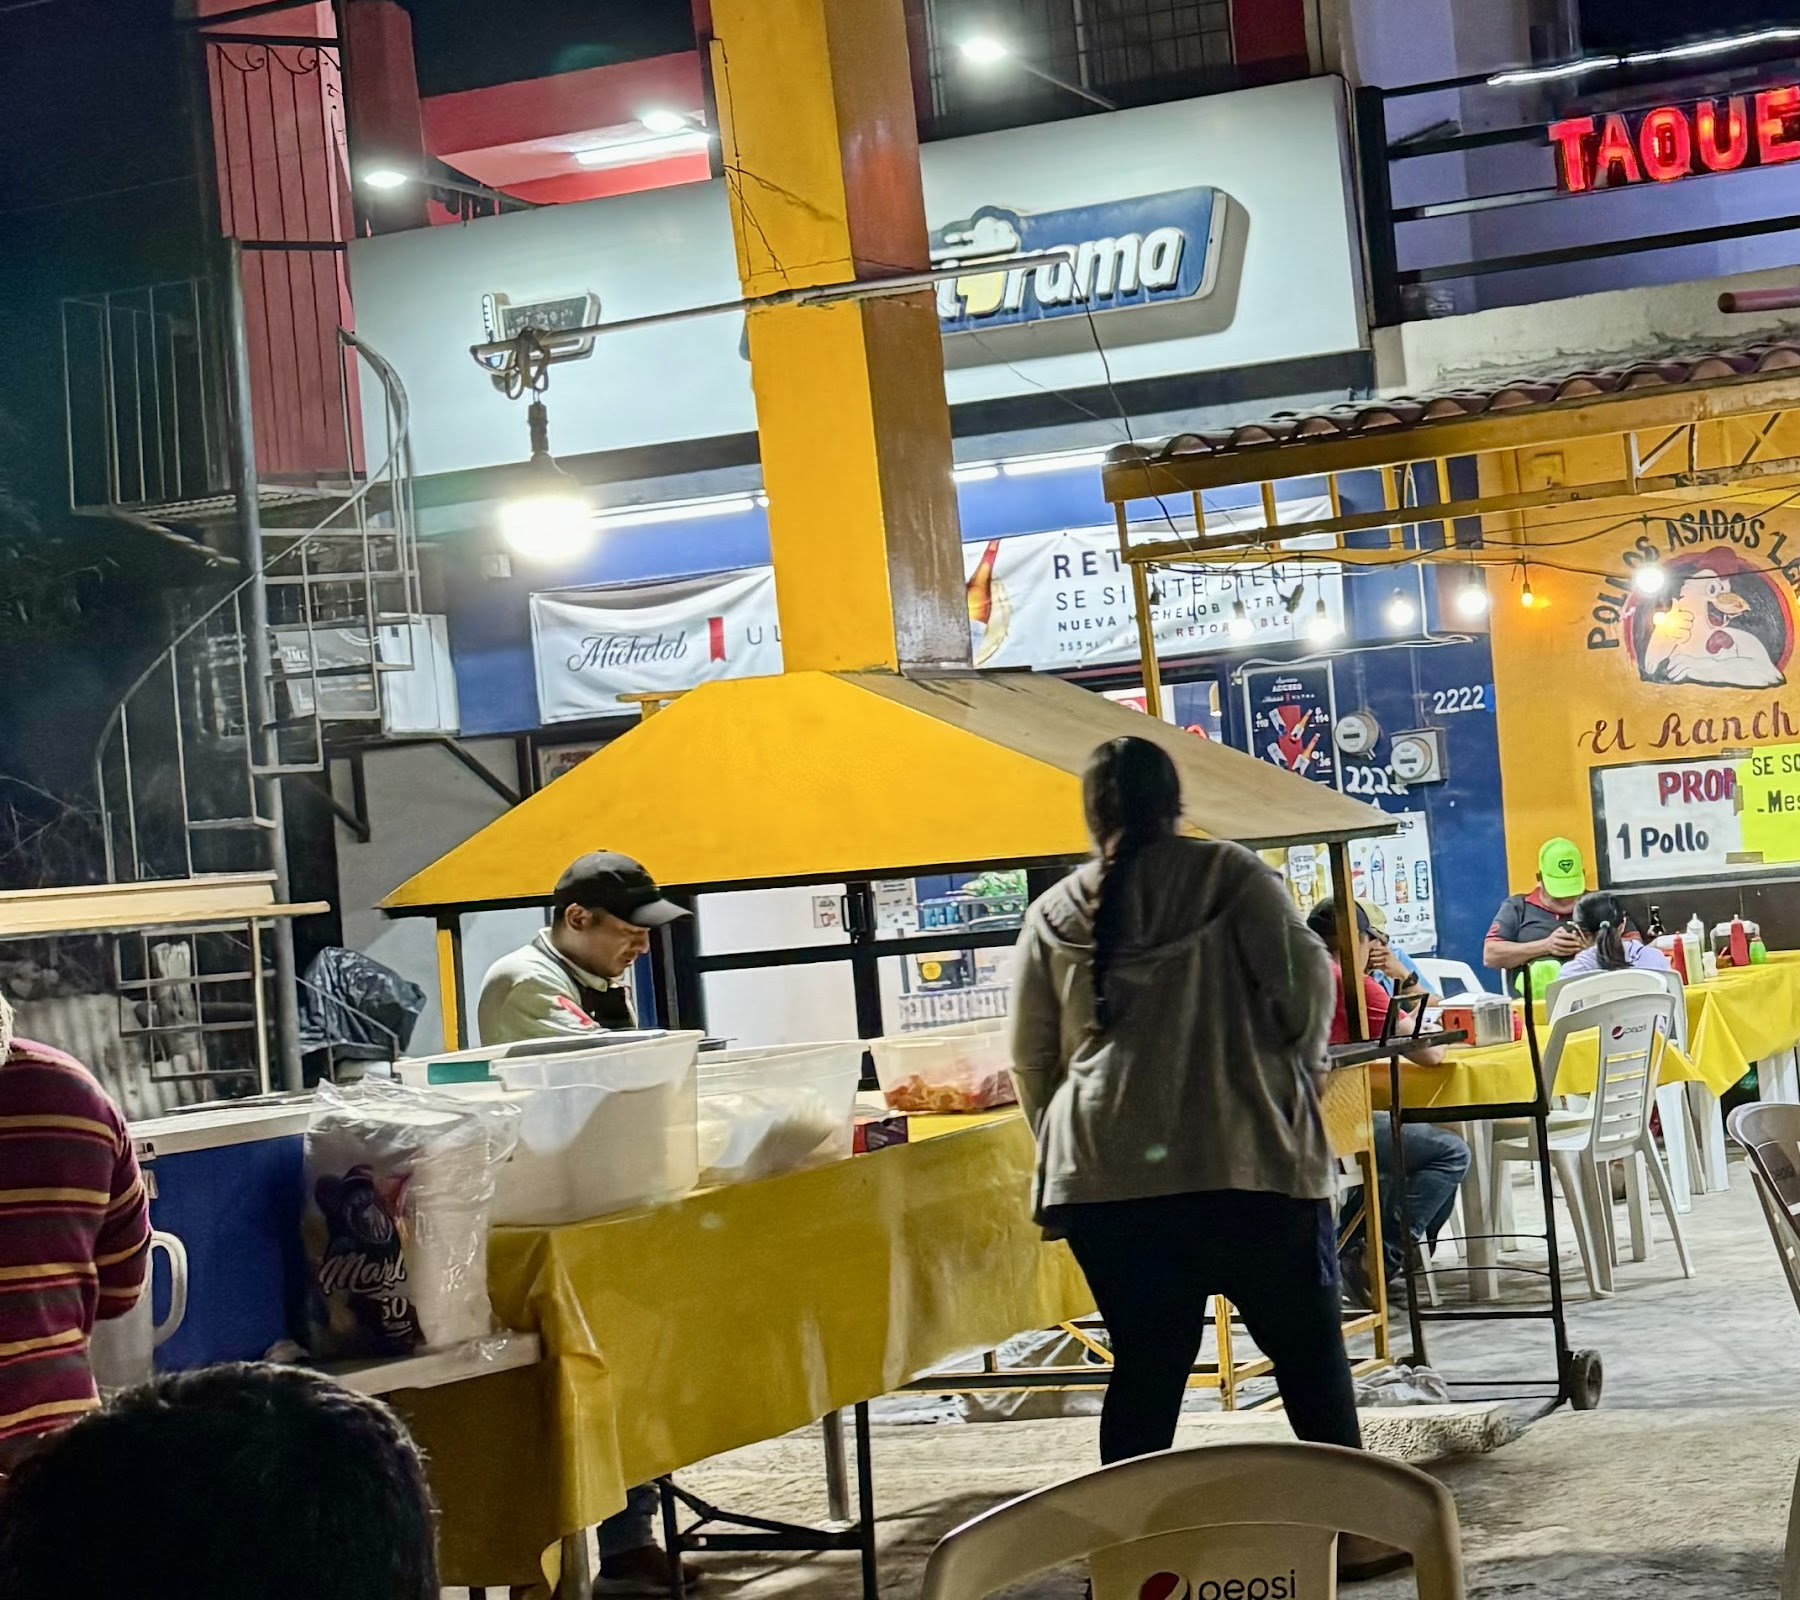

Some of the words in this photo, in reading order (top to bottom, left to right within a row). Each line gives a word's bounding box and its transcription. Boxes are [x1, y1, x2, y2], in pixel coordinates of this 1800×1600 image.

[1665, 509, 1765, 551] ASADOS
[1053, 549, 1122, 580] RET
[1056, 589, 1087, 611] SE
[1103, 577, 1206, 606] SINTE
[1058, 617, 1117, 632] NUEVA
[567, 631, 688, 672] Michelob
[747, 625, 782, 645] UL
[1432, 684, 1485, 715] 2222
[1751, 755, 1774, 777] SE
[1616, 822, 1631, 860] 1
[1640, 822, 1710, 859] Pollo
